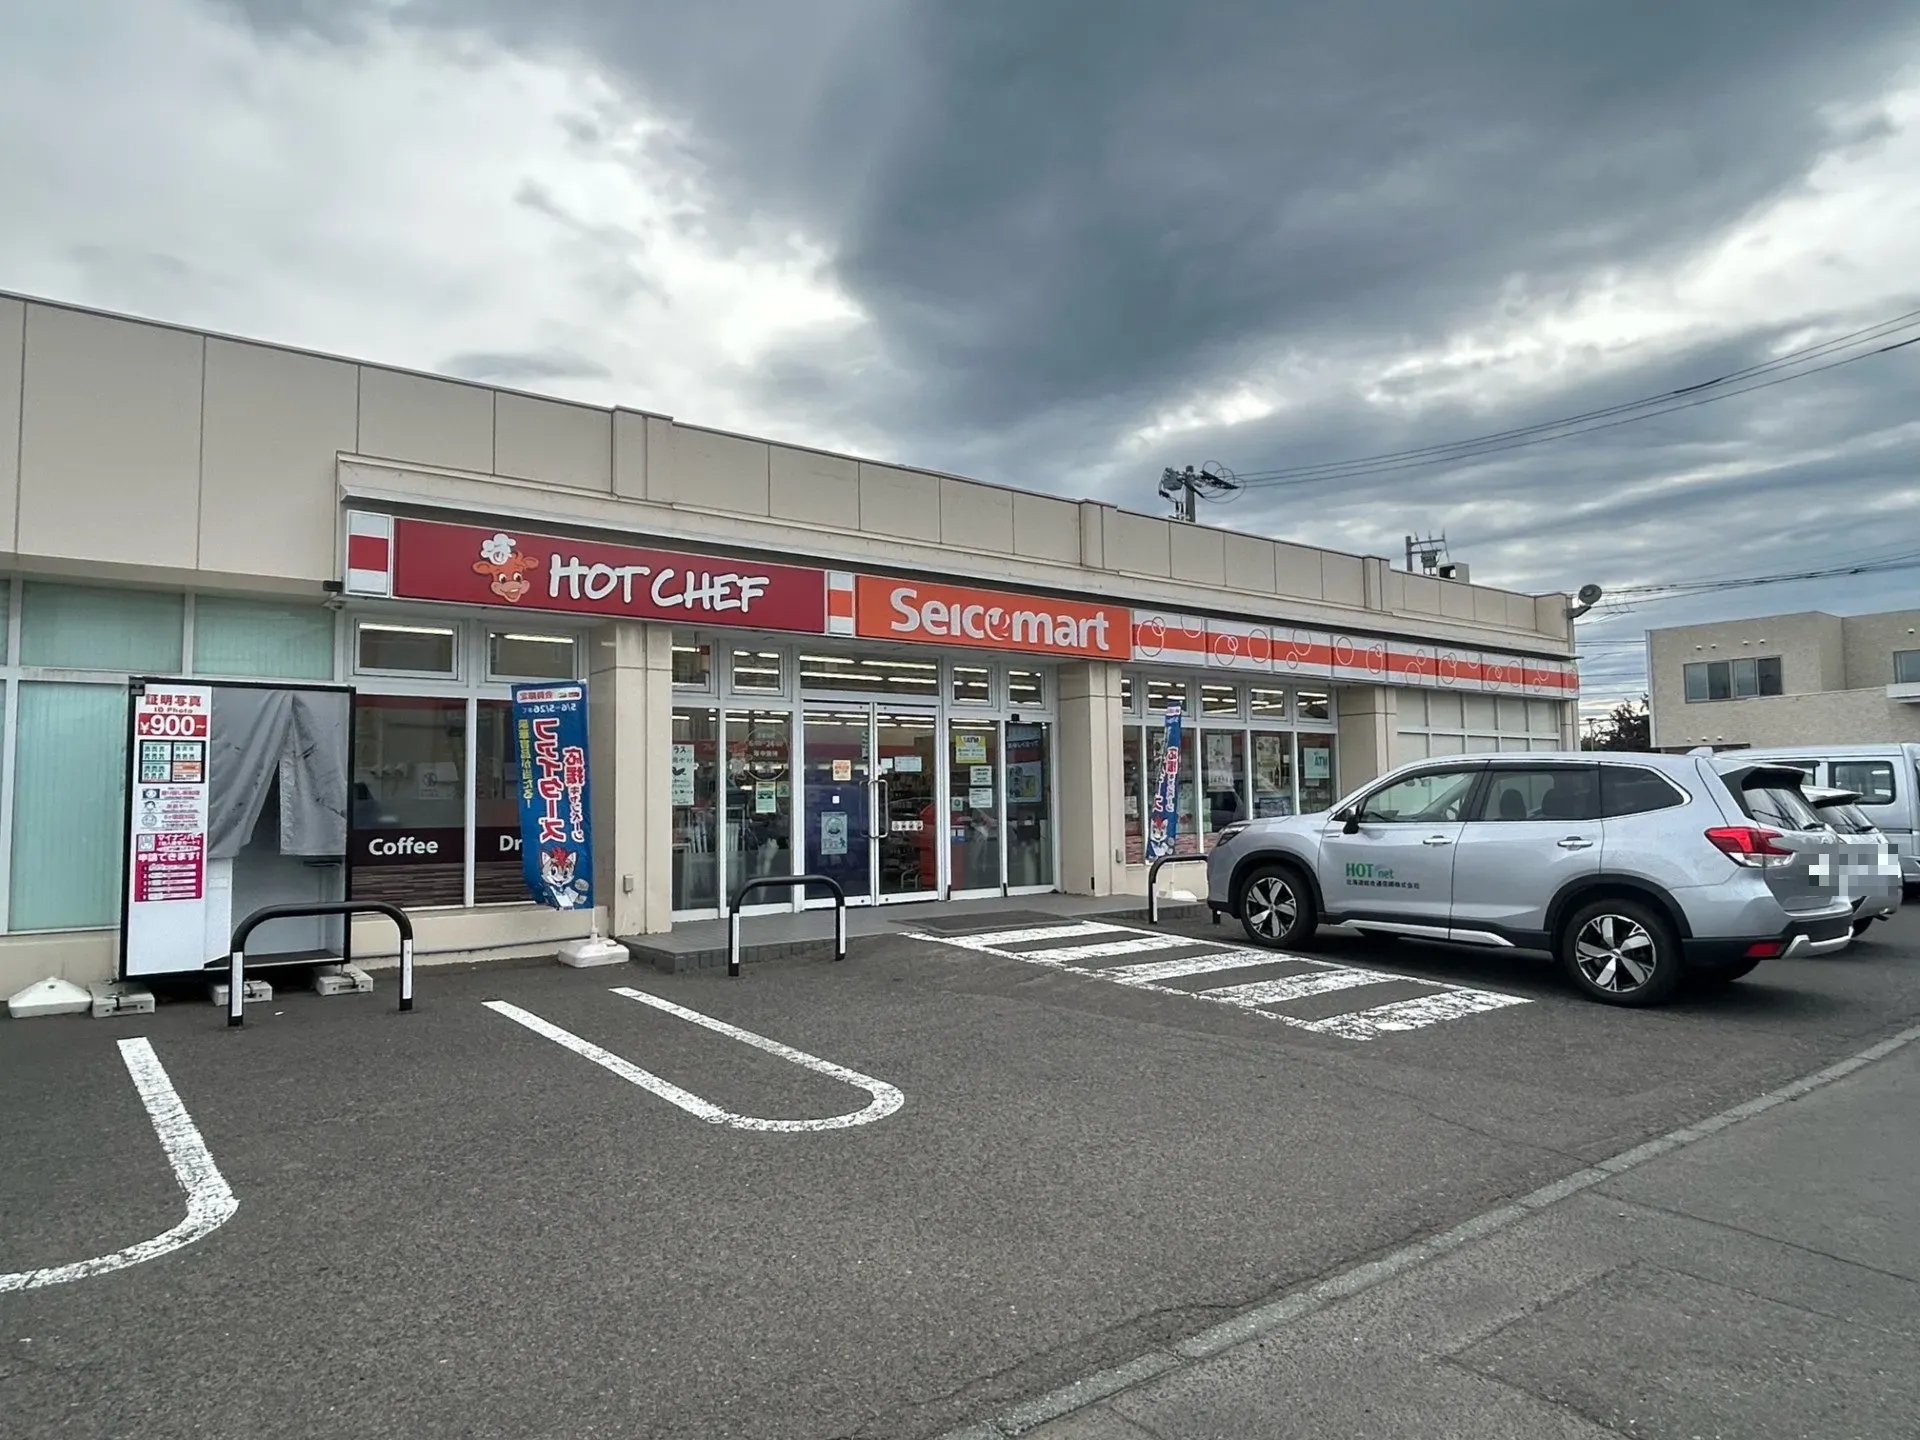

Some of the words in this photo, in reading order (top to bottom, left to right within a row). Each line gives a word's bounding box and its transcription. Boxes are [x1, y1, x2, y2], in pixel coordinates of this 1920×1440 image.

[547, 552, 650, 604] HOT
[650, 567, 770, 614] CHEF
[889, 586, 1109, 651] Seicomart
[145, 693, 202, 707] 証明写真
[368, 835, 439, 856] Coffee
[1345, 862, 1374, 878] HOT
[1377, 868, 1395, 880] net
